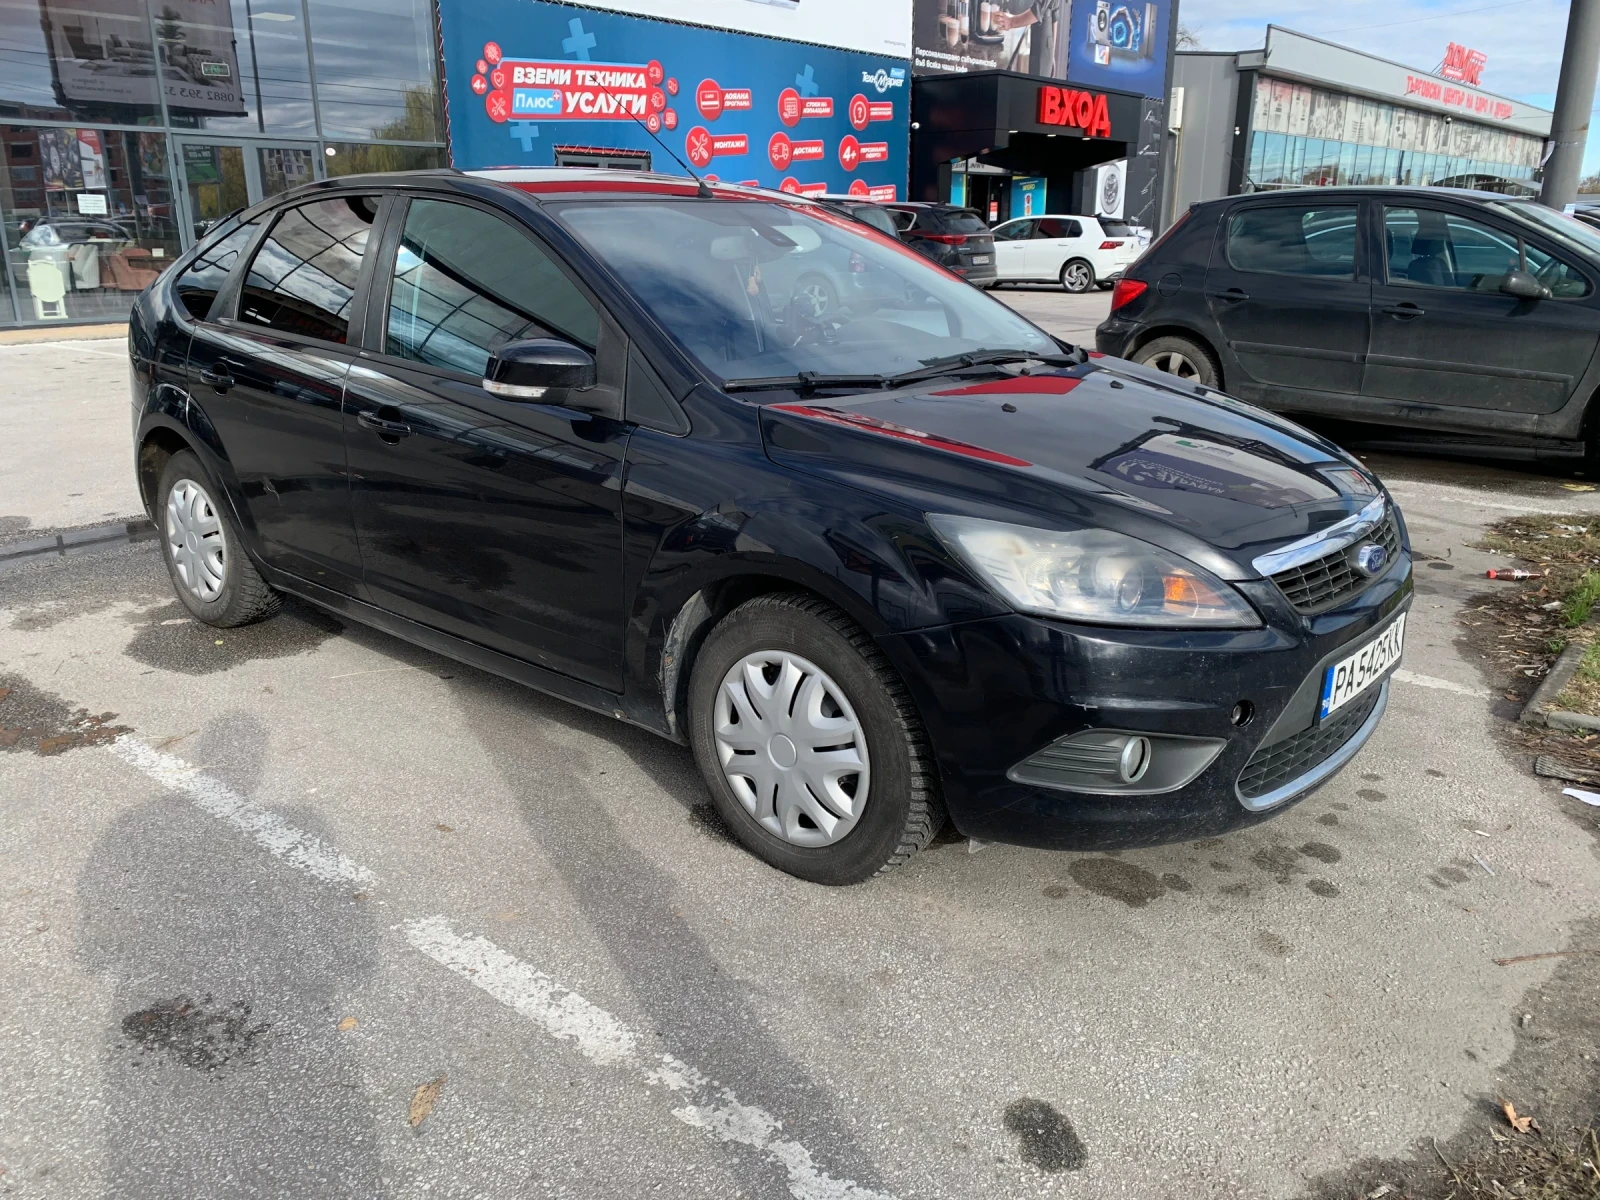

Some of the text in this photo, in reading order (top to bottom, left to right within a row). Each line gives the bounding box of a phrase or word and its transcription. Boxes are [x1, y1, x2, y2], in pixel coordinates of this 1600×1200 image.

[915, 46, 997, 68] Персонализирано съвършенство
[926, 59, 941, 69] всяка
[513, 66, 647, 88] ВЗЕМИ ТЕХНИКА
[515, 91, 647, 115] Плюс УСЛУГИ
[724, 92, 749, 100] ЛОЯЛНА
[1040, 85, 1111, 137] ВХОД
[713, 140, 746, 149] МОНТАЖИ
[793, 146, 822, 155] ДОСТАВКА
